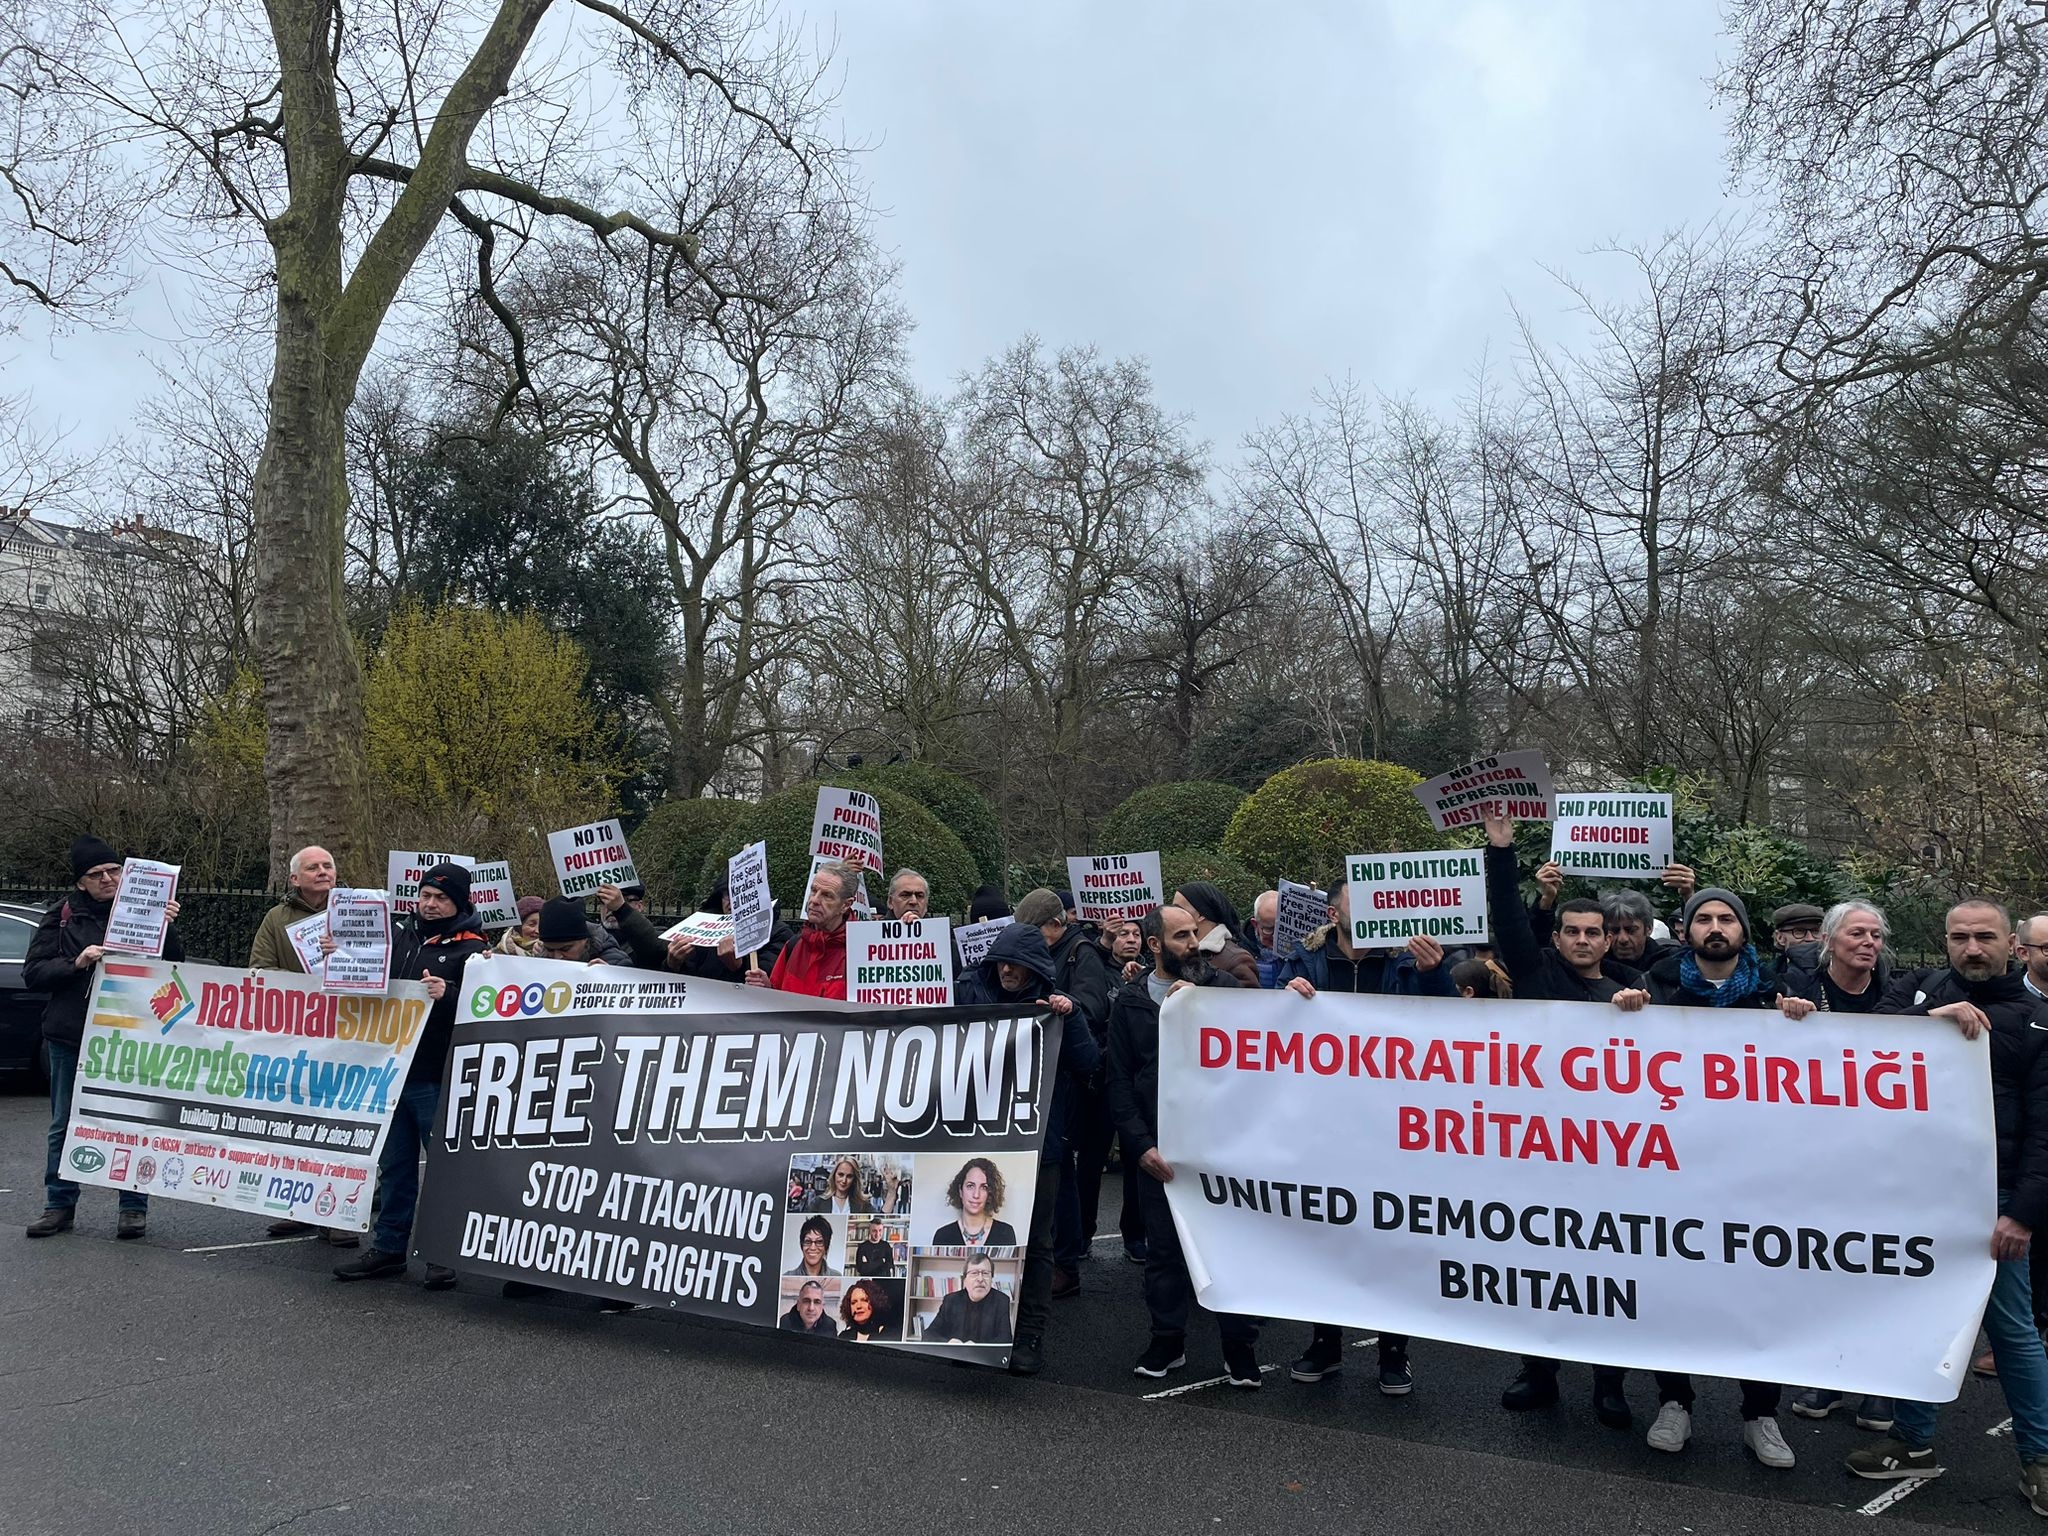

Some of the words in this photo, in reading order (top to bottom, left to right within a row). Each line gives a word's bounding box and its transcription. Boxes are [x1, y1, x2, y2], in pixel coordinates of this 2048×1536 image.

[1450, 766, 1472, 780] NO
[1473, 757, 1498, 772] TO
[1440, 767, 1526, 796] POLITICAL
[849, 791, 865, 808] NO
[1435, 782, 1544, 812] REPRESSION,
[1507, 801, 1547, 819] NOW
[1558, 800, 1583, 817] END
[1588, 801, 1668, 818] POLITICAL
[574, 829, 594, 847] NO
[596, 825, 613, 842] TO
[1570, 826, 1649, 844] GENOCIDE
[417, 854, 434, 866] NO
[564, 845, 626, 872] POLITICAL
[1092, 857, 1109, 870] NO
[1111, 856, 1128, 869] TO
[471, 867, 508, 883] OLITICAL
[756, 872, 763, 885] &
[1351, 862, 1385, 881] END
[1389, 858, 1480, 880] POLITICAL
[1084, 871, 1144, 887] POLITICAL
[147, 900, 167, 908] RIGHTS
[740, 890, 759, 908] those
[1079, 887, 1154, 904] REPRESSION,
[1280, 895, 1304, 911] Free
[1373, 888, 1462, 910] GENOCIDE
[337, 908, 347, 917] END
[394, 899, 420, 912] JUST
[734, 899, 760, 921] arrested
[1127, 903, 1157, 918] NOW
[341, 919, 365, 928] ATTACKS
[366, 920, 374, 928] ON
[881, 922, 902, 938] NO
[905, 921, 922, 938] TO
[1279, 915, 1292, 926] all
[1294, 919, 1316, 932] thos
[1355, 916, 1484, 940] OPERATIONS...!
[332, 929, 365, 939] DEMOCRATIC
[366, 930, 385, 939] RIGHTS
[867, 943, 937, 961] POLITICAL
[962, 943, 984, 955] Free
[857, 965, 946, 984] REPRESSION,
[575, 983, 636, 994] SOLIDARITY
[638, 982, 666, 994] WITH
[668, 982, 687, 993] THE
[856, 988, 913, 1005] JUSTICE
[916, 987, 947, 1005] NOW
[475, 986, 567, 1014] SPOT
[572, 996, 615, 1009] PEOPLE
[618, 996, 635, 1009] OF
[638, 995, 686, 1009] TURKEY
[1199, 1025, 1545, 1089] DEMOKRATİK
[1560, 1036, 1683, 1111] GÜÇ
[1704, 1043, 1930, 1113] BİRLİĞİ
[445, 1035, 603, 1149] FREE
[612, 1032, 825, 1142] THEM
[829, 1018, 1043, 1138] NOW!
[179, 1106, 220, 1131] building
[221, 1112, 236, 1131] the
[238, 1115, 265, 1135] union
[267, 1120, 295, 1139] rank
[294, 1123, 315, 1141] and
[327, 1127, 352, 1146] since
[1399, 1099, 1681, 1172] BRİTANYA
[76, 1153, 98, 1166] RMT
[227, 1149, 270, 1166] supported
[270, 1154, 281, 1170] by
[282, 1156, 295, 1170] the
[239, 1170, 263, 1186] NUJ
[266, 1175, 315, 1210] napo
[522, 1161, 599, 1213] STOP
[598, 1171, 775, 1243] ATTACKING
[1199, 1172, 1358, 1225] UNITED
[1372, 1191, 1708, 1262] DEMOCRATIC
[1722, 1222, 1937, 1278] FORCES
[460, 1211, 646, 1287] DEMOCRATIC
[642, 1240, 762, 1309] RIGHTS
[1439, 1259, 1638, 1320] BRITAIN
